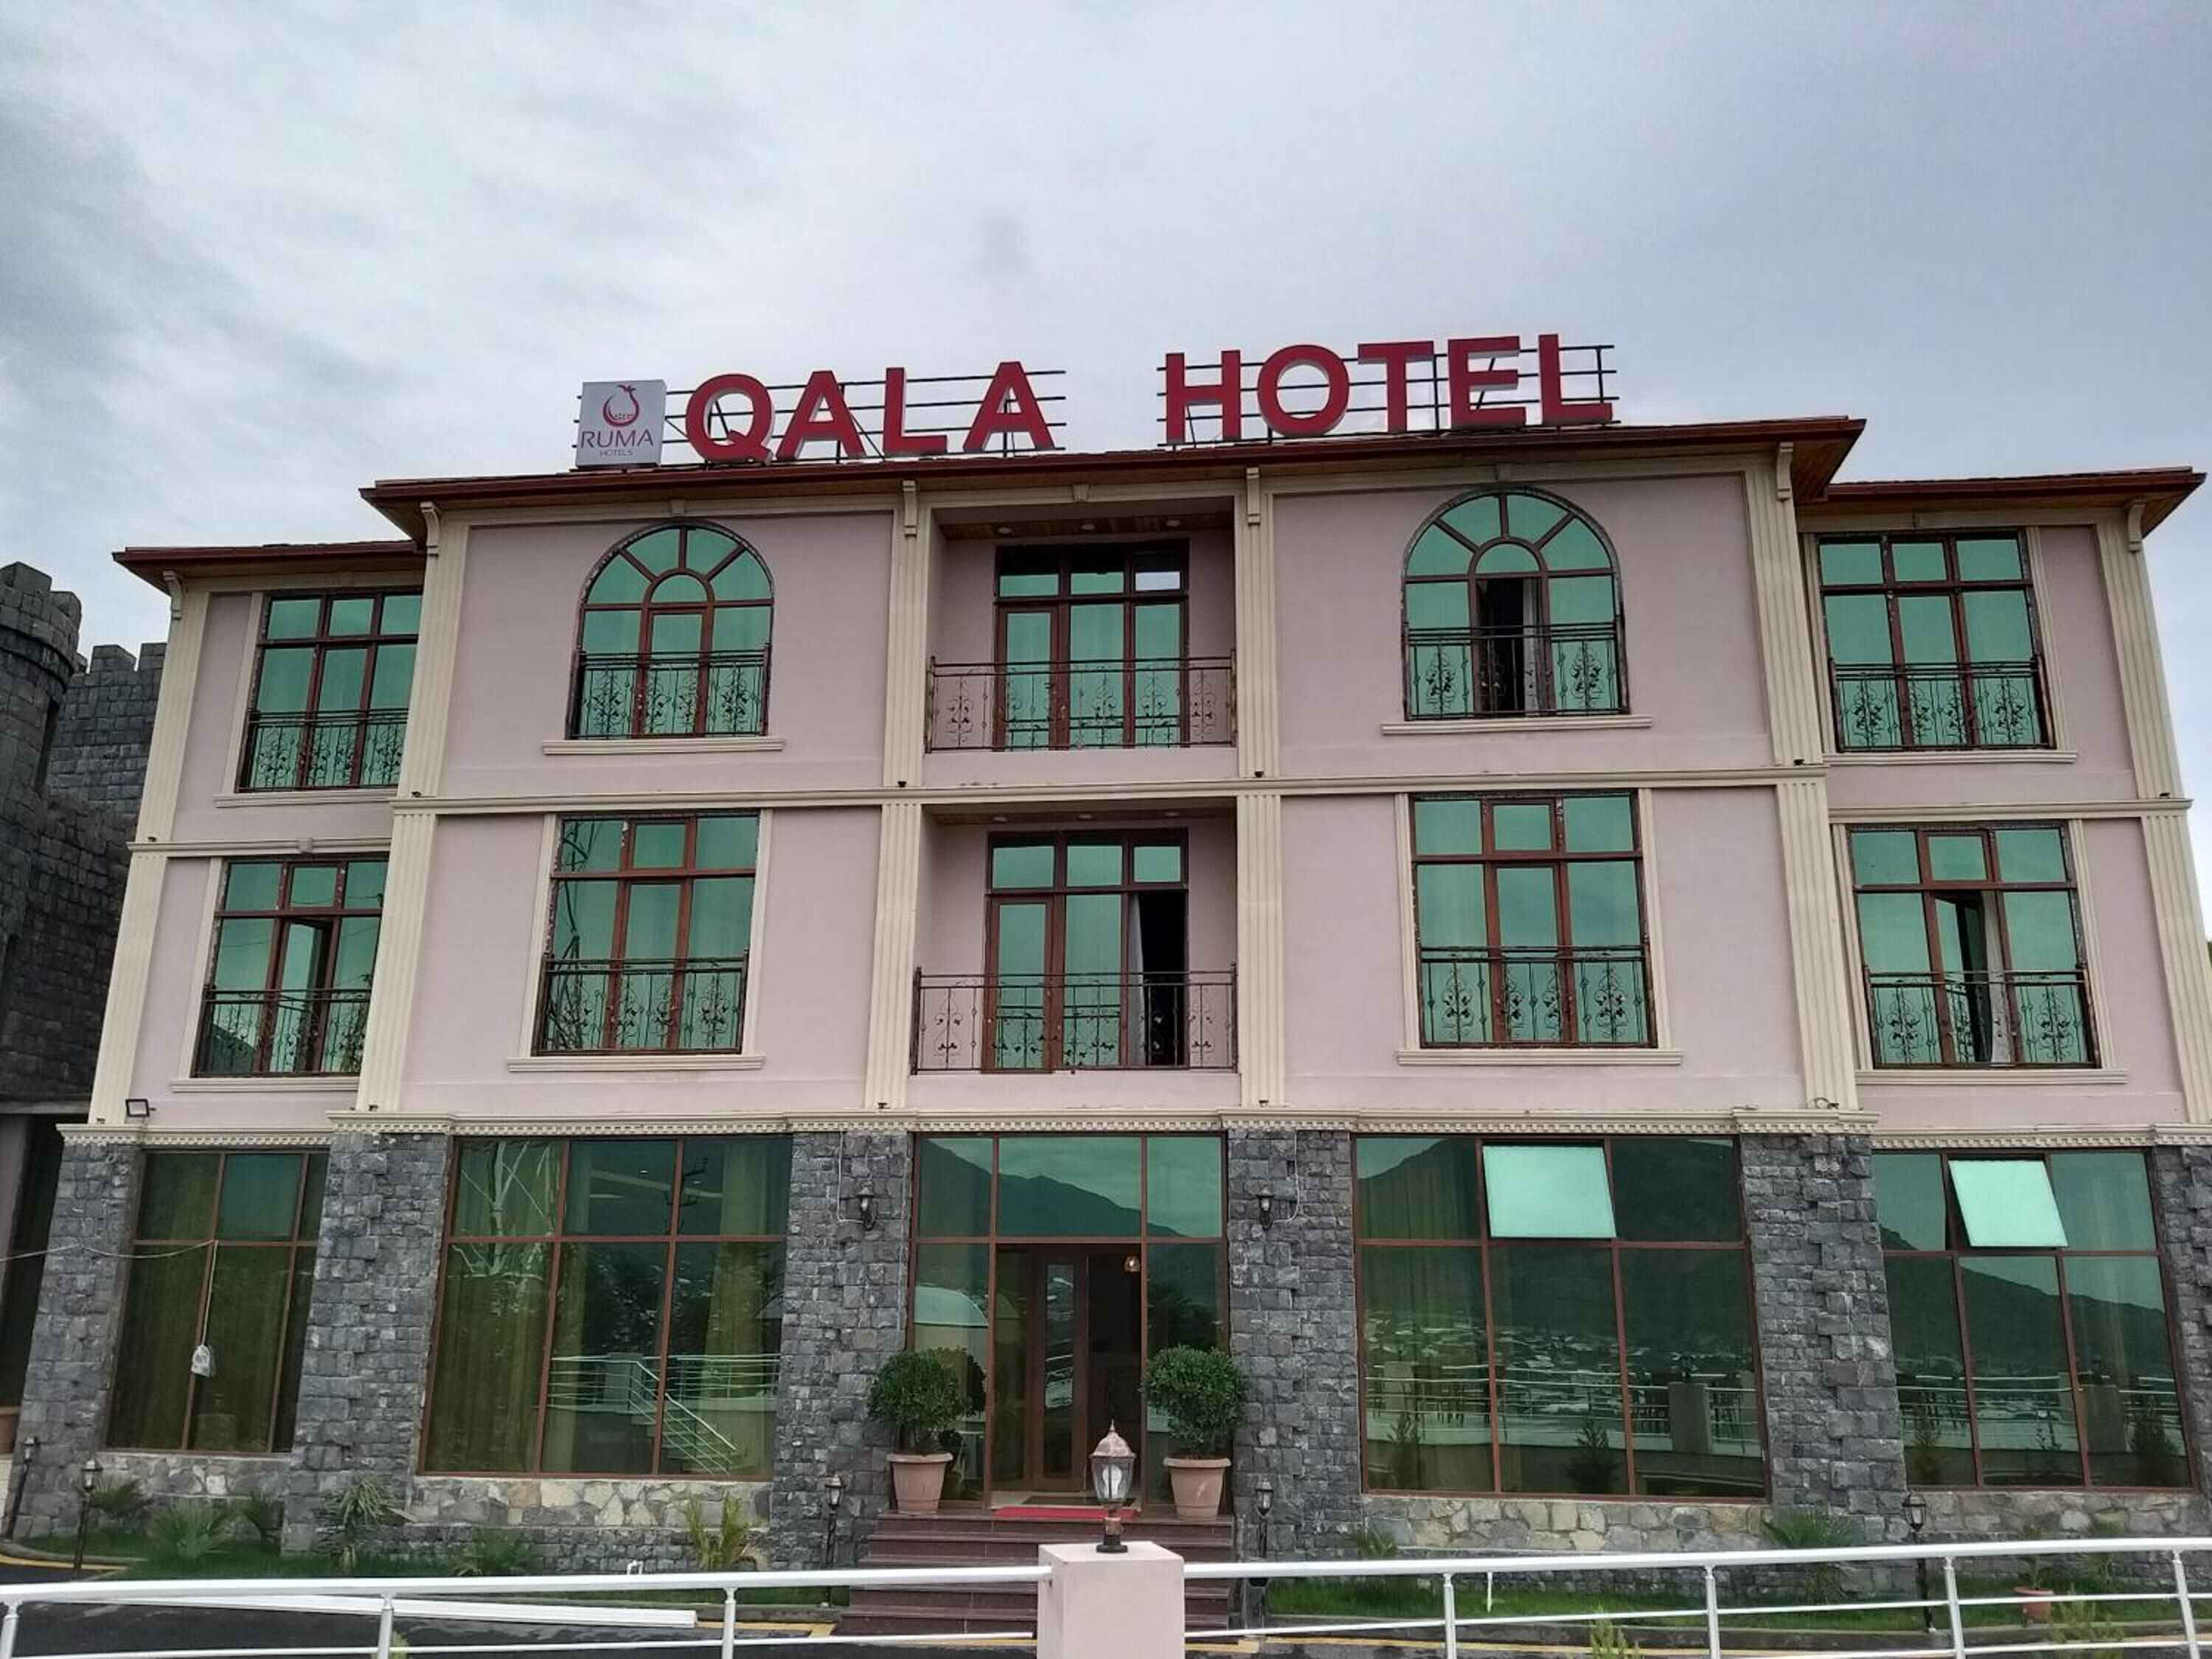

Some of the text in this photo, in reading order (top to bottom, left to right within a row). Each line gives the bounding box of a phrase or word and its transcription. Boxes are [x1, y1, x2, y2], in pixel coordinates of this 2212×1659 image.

[686, 334, 1613, 466] QALA HOTEL
[580, 428, 654, 448] RUMA
[599, 449, 633, 457] HOTELS
